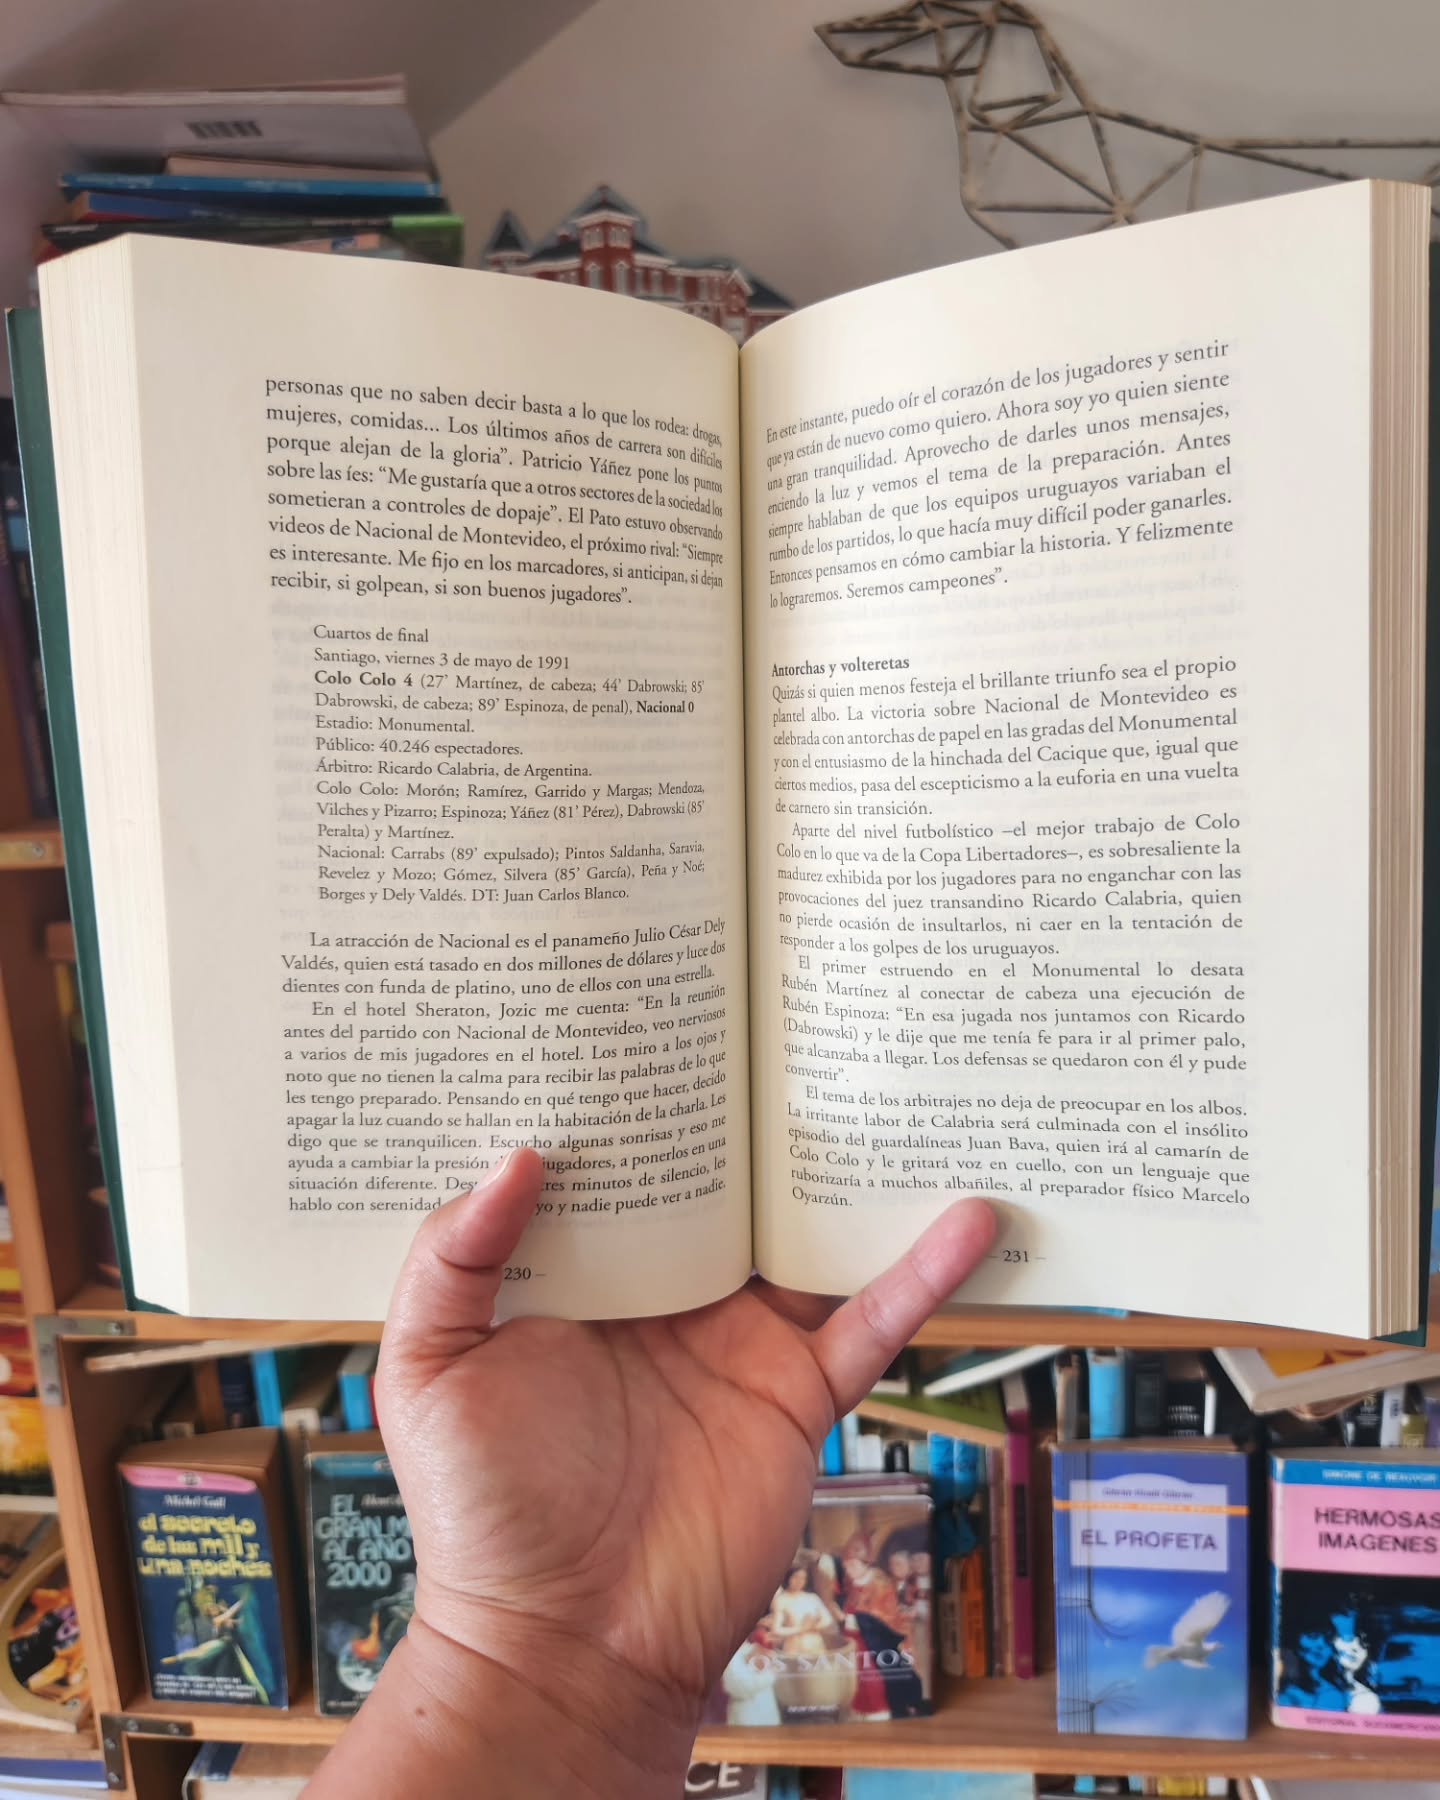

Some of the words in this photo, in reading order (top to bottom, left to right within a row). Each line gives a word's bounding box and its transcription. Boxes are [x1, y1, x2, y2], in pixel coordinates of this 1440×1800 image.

[265, 379, 344, 397] personas
[350, 386, 383, 404] que
[390, 389, 413, 402] no
[419, 386, 468, 407] saben
[474, 390, 517, 411] decir
[522, 394, 563, 417] basta
[568, 406, 576, 418] a
[582, 401, 597, 420] lo
[601, 411, 628, 428] que
[632, 409, 650, 428] los
[655, 416, 689, 436] rodea:
[692, 423, 722, 447] drogas,
[767, 478, 783, 491] una
[786, 471, 808, 491] gran
[814, 448, 897, 479] tranquilidad.
[905, 435, 990, 466] Aprovecho
[998, 429, 1018, 448] de
[1026, 421, 1077, 444] darles
[1086, 418, 1130, 435] unos
[1140, 405, 1229, 427] mensajes,
[266, 436, 331, 456] porque
[340, 435, 391, 460] alejan
[400, 439, 422, 458] de
[430, 441, 445, 460] la
[522, 449, 582, 472] Patricio
[589, 456, 632, 477] Yáñez
[638, 467, 669, 484] pone
[674, 467, 689, 486] los
[694, 477, 723, 494] puntos
[271, 570, 331, 591] recibir,
[337, 574, 350, 590] si
[356, 574, 429, 598] golpean,
[434, 578, 448, 595] si
[452, 584, 482, 597] son
[488, 580, 546, 600] buenos
[770, 593, 778, 608] lo
[780, 590, 842, 611] lograremos.
[847, 583, 904, 599] Seremos
[313, 624, 372, 640] Cuartos
[375, 626, 393, 642] de
[398, 627, 429, 643] final
[314, 647, 380, 668] Santiago,
[385, 650, 435, 666] viernes
[439, 652, 448, 667] 3
[453, 652, 470, 667] de
[474, 657, 512, 672] mayo
[516, 654, 533, 669] de
[538, 656, 569, 670] 1991
[772, 660, 826, 677] Antorchas
[828, 663, 837, 678] y
[840, 656, 910, 672] volteretas
[773, 708, 805, 728] plantel
[811, 706, 840, 722] albo.
[848, 706, 864, 721] La
[871, 703, 926, 720] victoria
[934, 700, 976, 717] sobre
[984, 693, 1059, 714] Nacional
[1069, 692, 1090, 709] de
[1100, 684, 1209, 707] Montevideo
[1220, 687, 1237, 699] es
[315, 714, 373, 730] Estadio:
[378, 716, 474, 733] Monumental.
[315, 736, 375, 752] Público:
[379, 738, 430, 754] 40.246
[434, 740, 523, 758] espectadores.
[315, 756, 373, 774] Árbitro:
[378, 760, 433, 775] Ricardo
[437, 761, 499, 777] Calabria,
[503, 762, 520, 777] de
[523, 763, 592, 781] Argentina.
[316, 780, 352, 795] Colo
[359, 781, 398, 796] Colo:
[406, 782, 460, 799] Morón;
[468, 783, 528, 800] Ramírez,
[534, 784, 587, 798] Garrido
[592, 788, 601, 801] y
[606, 784, 652, 801] Margas;
[658, 781, 705, 796] Mendoza,
[775, 798, 786, 813] de
[788, 804, 830, 815] carnero
[834, 800, 853, 815] sin
[857, 800, 932, 815] transición.
[319, 886, 366, 904] Borges
[369, 892, 378, 904] y
[382, 887, 415, 905] Dely
[418, 888, 466, 902] Valdés.
[472, 888, 499, 902] DT:
[502, 888, 534, 905] Juan
[538, 887, 580, 901] Carlos
[584, 886, 629, 900] Blanco.
[310, 932, 330, 947] La
[335, 933, 409, 948] atracción
[414, 932, 434, 948] de
[438, 932, 510, 949] Nacional
[514, 938, 530, 948] es
[534, 932, 547, 948] el
[552, 931, 630, 953] panameño
[632, 926, 666, 947] Julio
[668, 924, 702, 940] César
[704, 917, 726, 936] Dely
[799, 955, 810, 970] El
[822, 959, 867, 976] primer
[880, 962, 954, 977] estruendo
[968, 968, 987, 978] en
[1002, 962, 1016, 978] el
[1032, 961, 1140, 977] Monumental
[1157, 961, 1173, 976] lo
[1190, 960, 1244, 976] desata
[312, 1001, 334, 1016] En
[343, 1001, 356, 1016] el
[366, 1001, 406, 1017] hotel
[416, 1001, 490, 1019] Sheraton,
[498, 1002, 537, 1021] Jozic
[545, 1006, 569, 1017] me
[576, 1002, 629, 1016] cuenta:
[670, 992, 681, 1007] la
[687, 984, 726, 1004] reunión
[791, 1167, 861, 1187] ruborizaría
[867, 1179, 875, 1188] a
[881, 1175, 938, 1189] muchos
[944, 1175, 1013, 1192] albañiles,
[1020, 1178, 1032, 1192] al
[1040, 1181, 1125, 1198] preparador
[1132, 1183, 1174, 1199] físico
[1182, 1186, 1250, 1204] Marcelo
[792, 1186, 853, 1206] Oyarzún.
[1002, 1249, 1029, 1263] 231
[504, 1266, 532, 1281] 230
[330, 1494, 361, 1516] EL
[314, 1516, 382, 1539] GRAN
[1314, 1507, 1440, 1529] HERMOSAS
[1081, 1529, 1107, 1546] EL
[1115, 1530, 1217, 1550] PROFETA
[1318, 1531, 1438, 1553] IMAGENES
[186, 1555, 273, 1578] noches
[326, 1560, 392, 1587] 2000
[797, 1648, 914, 1674] SANTOS
